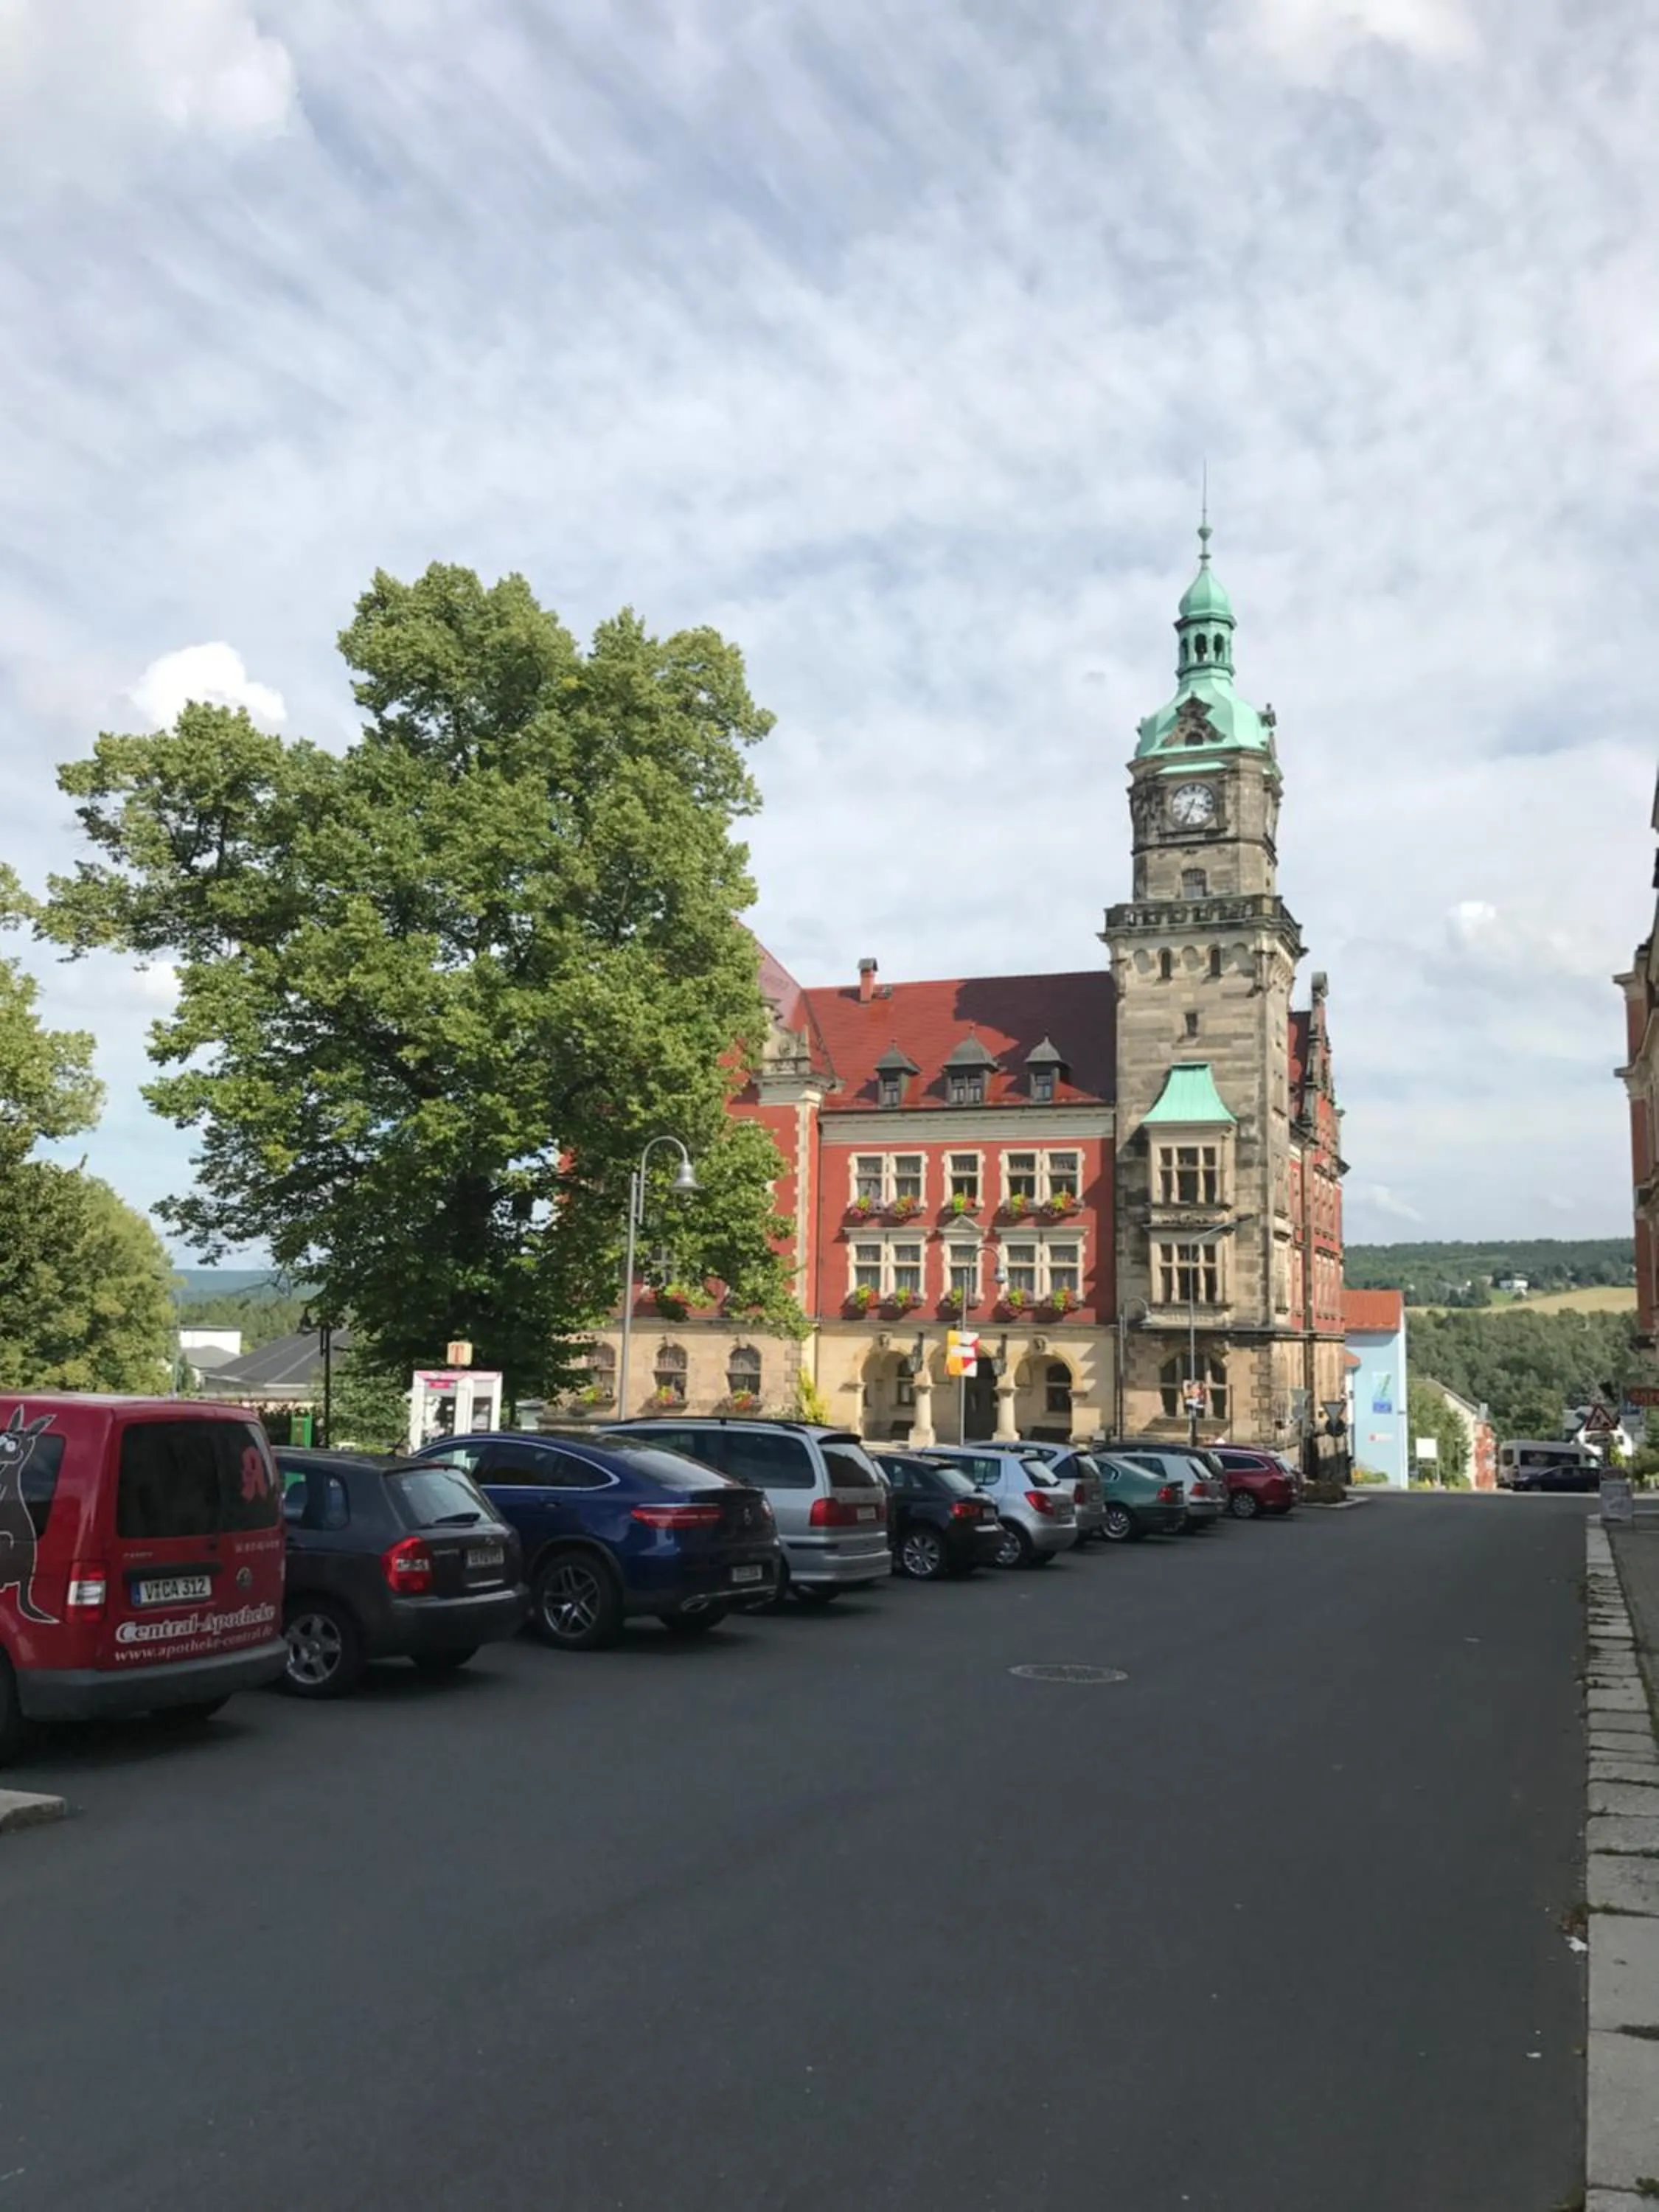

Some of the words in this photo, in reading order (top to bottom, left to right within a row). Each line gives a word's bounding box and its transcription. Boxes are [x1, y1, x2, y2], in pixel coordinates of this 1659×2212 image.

[184, 1577, 206, 1596] 312
[115, 1602, 276, 1644] Central-Apotheke
[115, 1625, 273, 1661] www.apotheke-central.de
